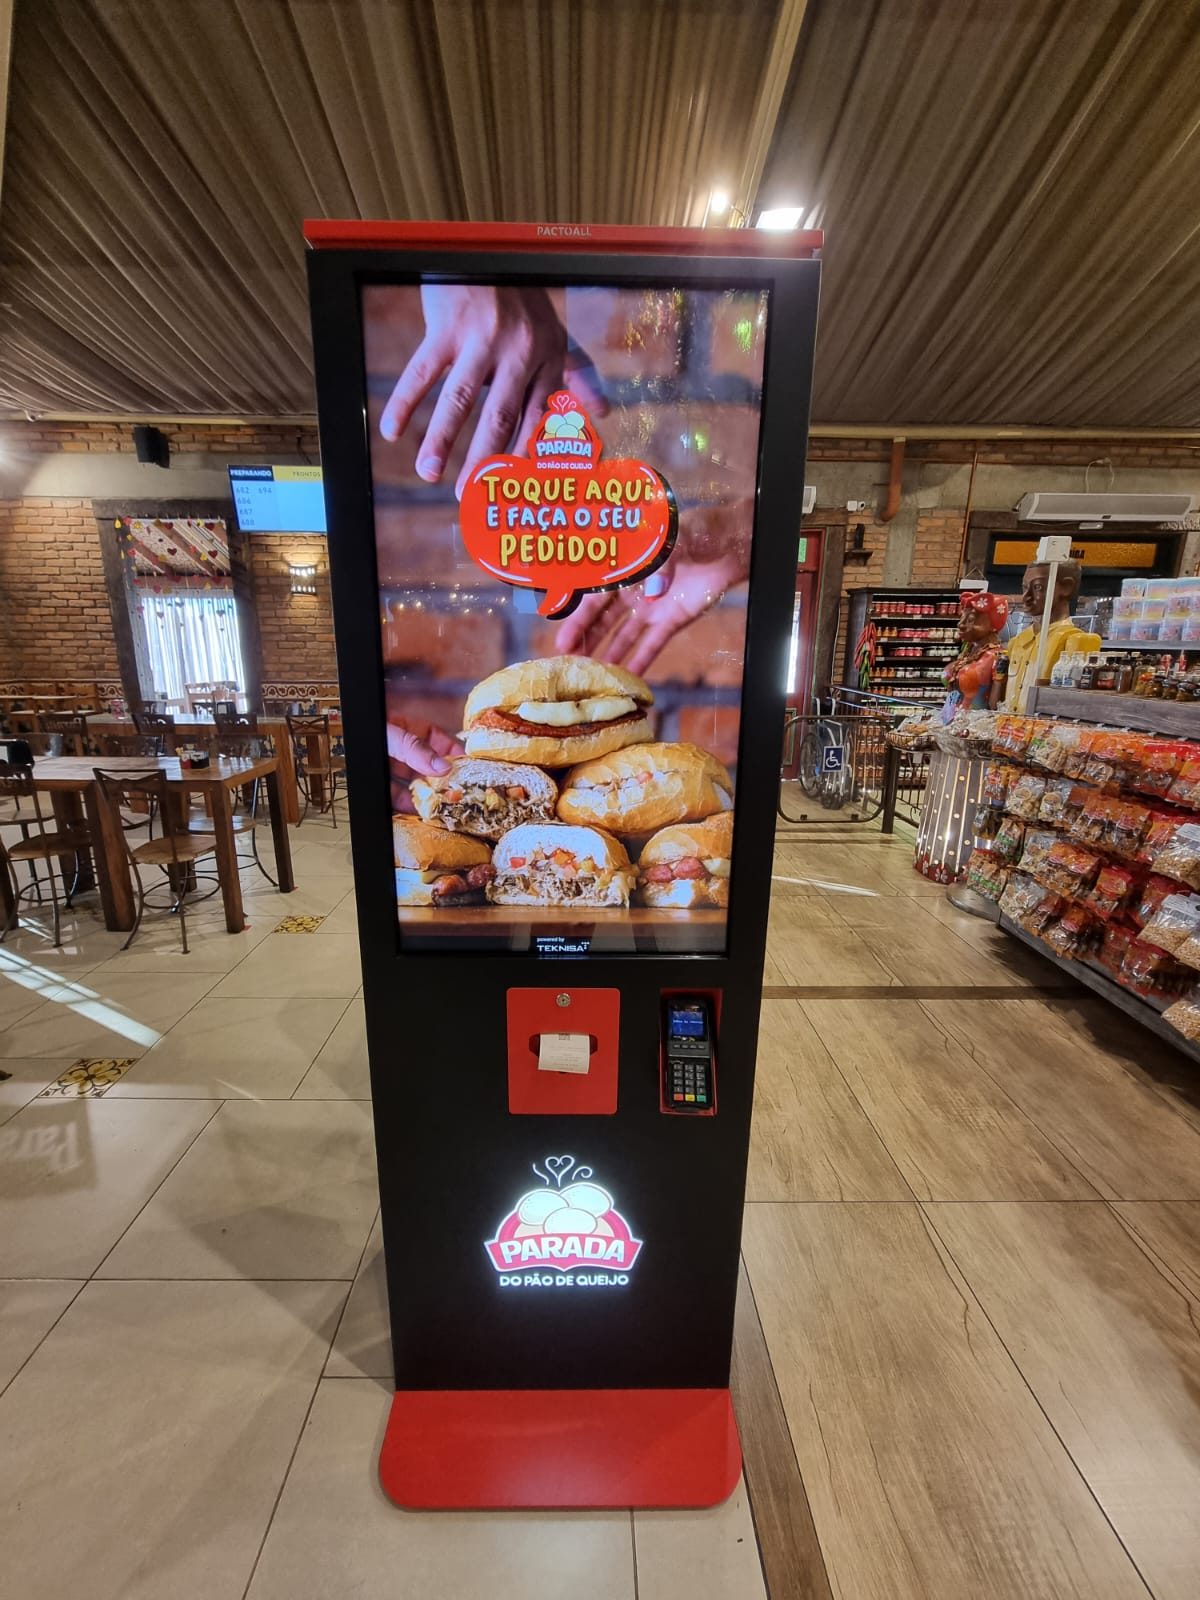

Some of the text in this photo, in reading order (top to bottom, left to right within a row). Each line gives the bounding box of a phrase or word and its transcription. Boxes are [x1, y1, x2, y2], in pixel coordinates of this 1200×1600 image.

[536, 440, 592, 457] PARADA
[570, 462, 592, 470] QUEIJO
[482, 476, 576, 505] TOQUE
[487, 506, 641, 531] E FAÇA O SEU
[500, 1236, 625, 1264] PARADA
[500, 1273, 629, 1287] DO PÃO DE QUEIJO
